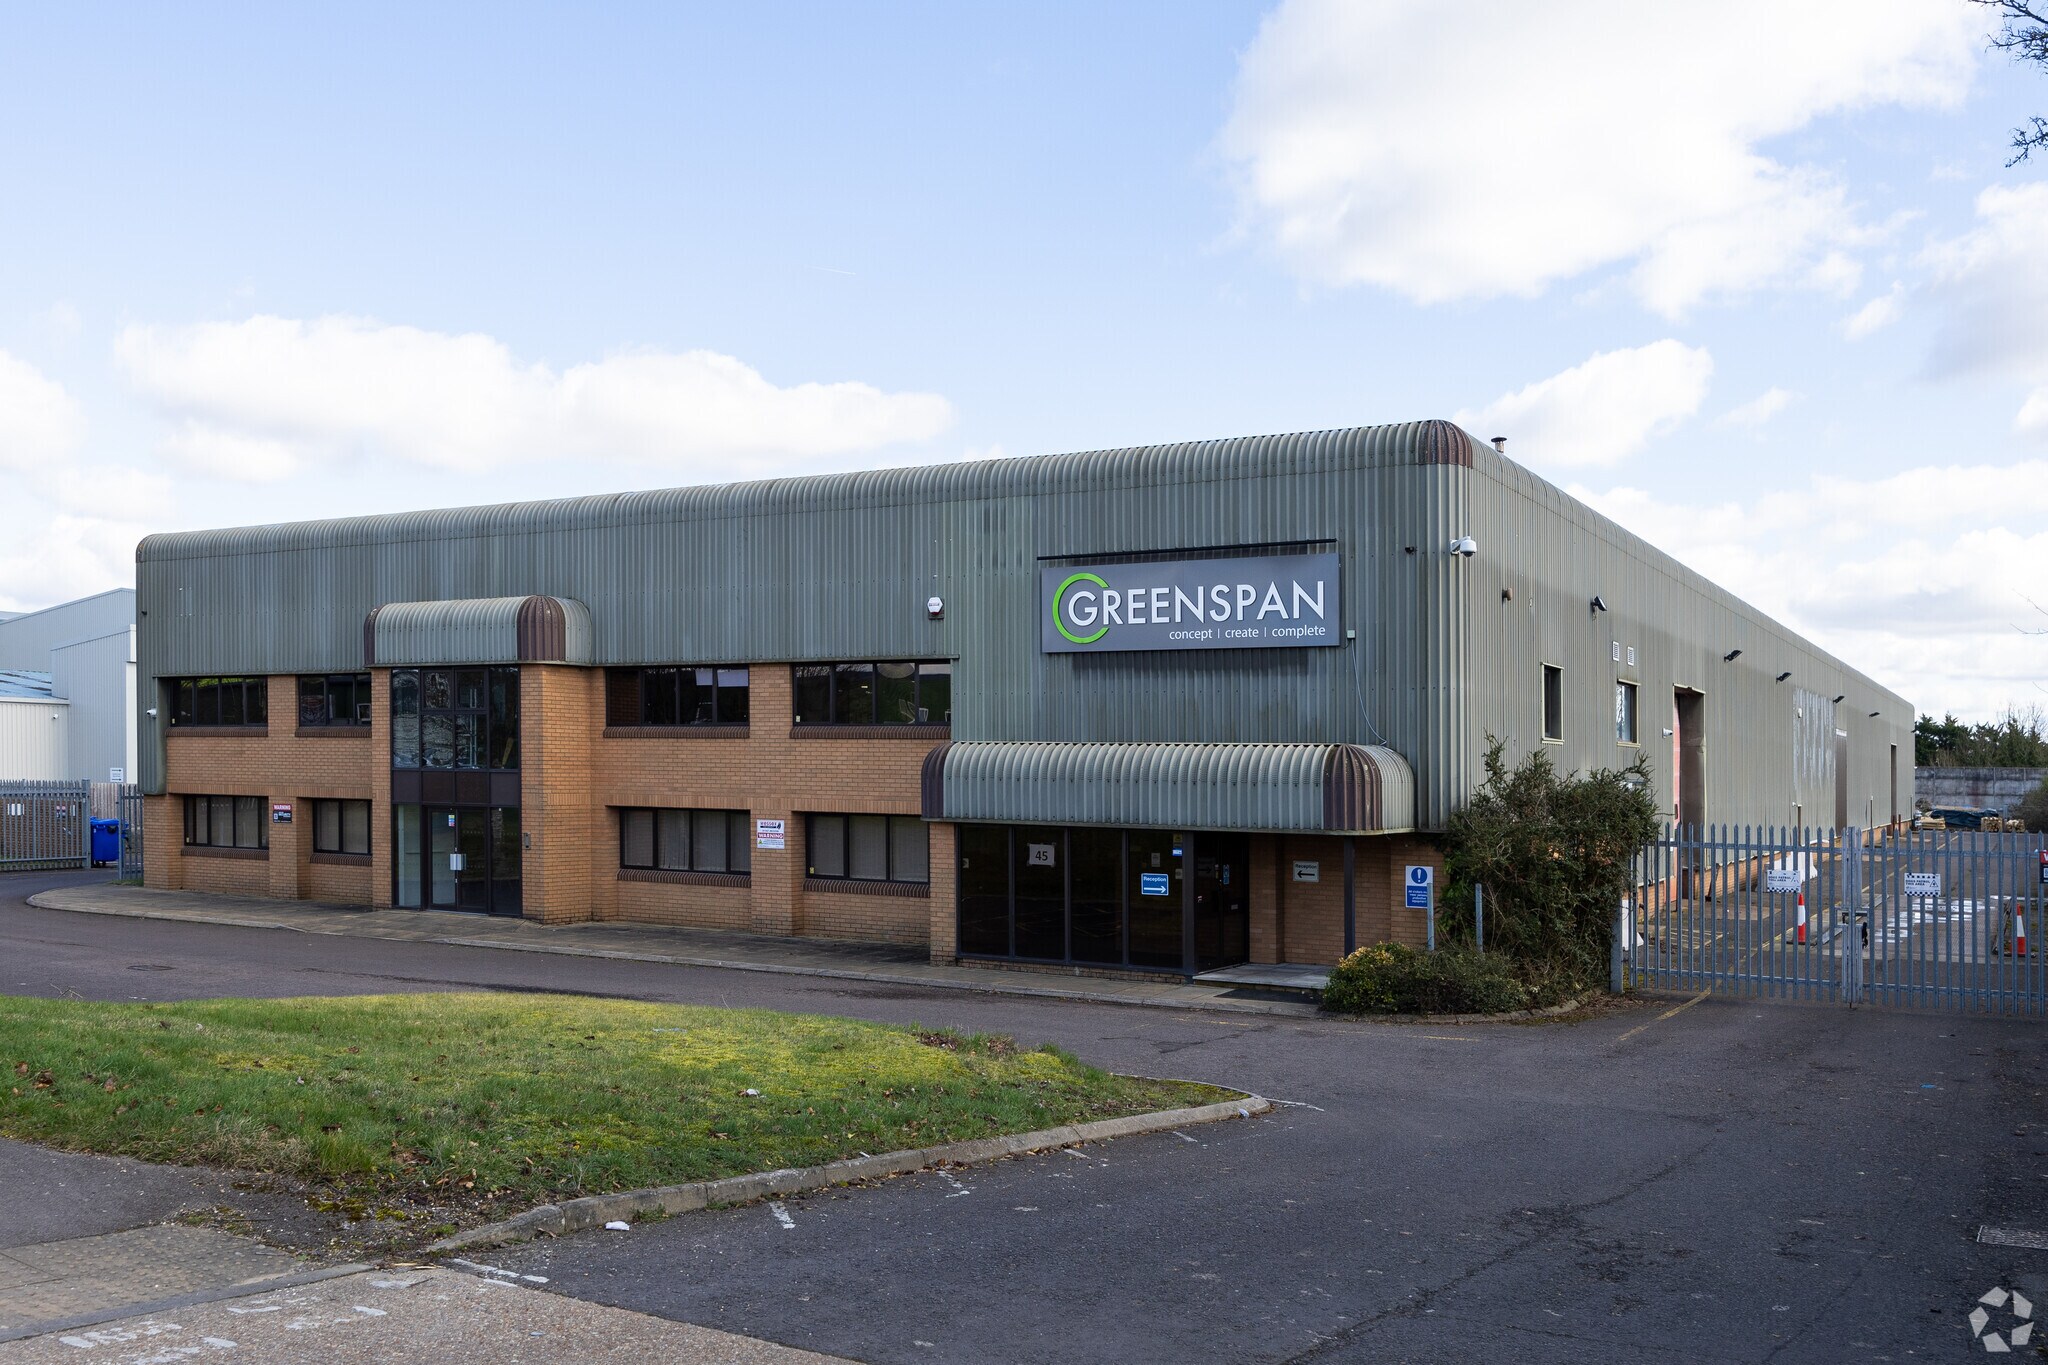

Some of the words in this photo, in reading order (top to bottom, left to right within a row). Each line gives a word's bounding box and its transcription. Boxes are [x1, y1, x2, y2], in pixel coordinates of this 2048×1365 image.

[1068, 579, 1325, 626] GREENSPAN
[1169, 628, 1213, 641] concept
[1225, 627, 1259, 639] create
[1271, 624, 1326, 640] complete
[1035, 850, 1048, 861] 45
